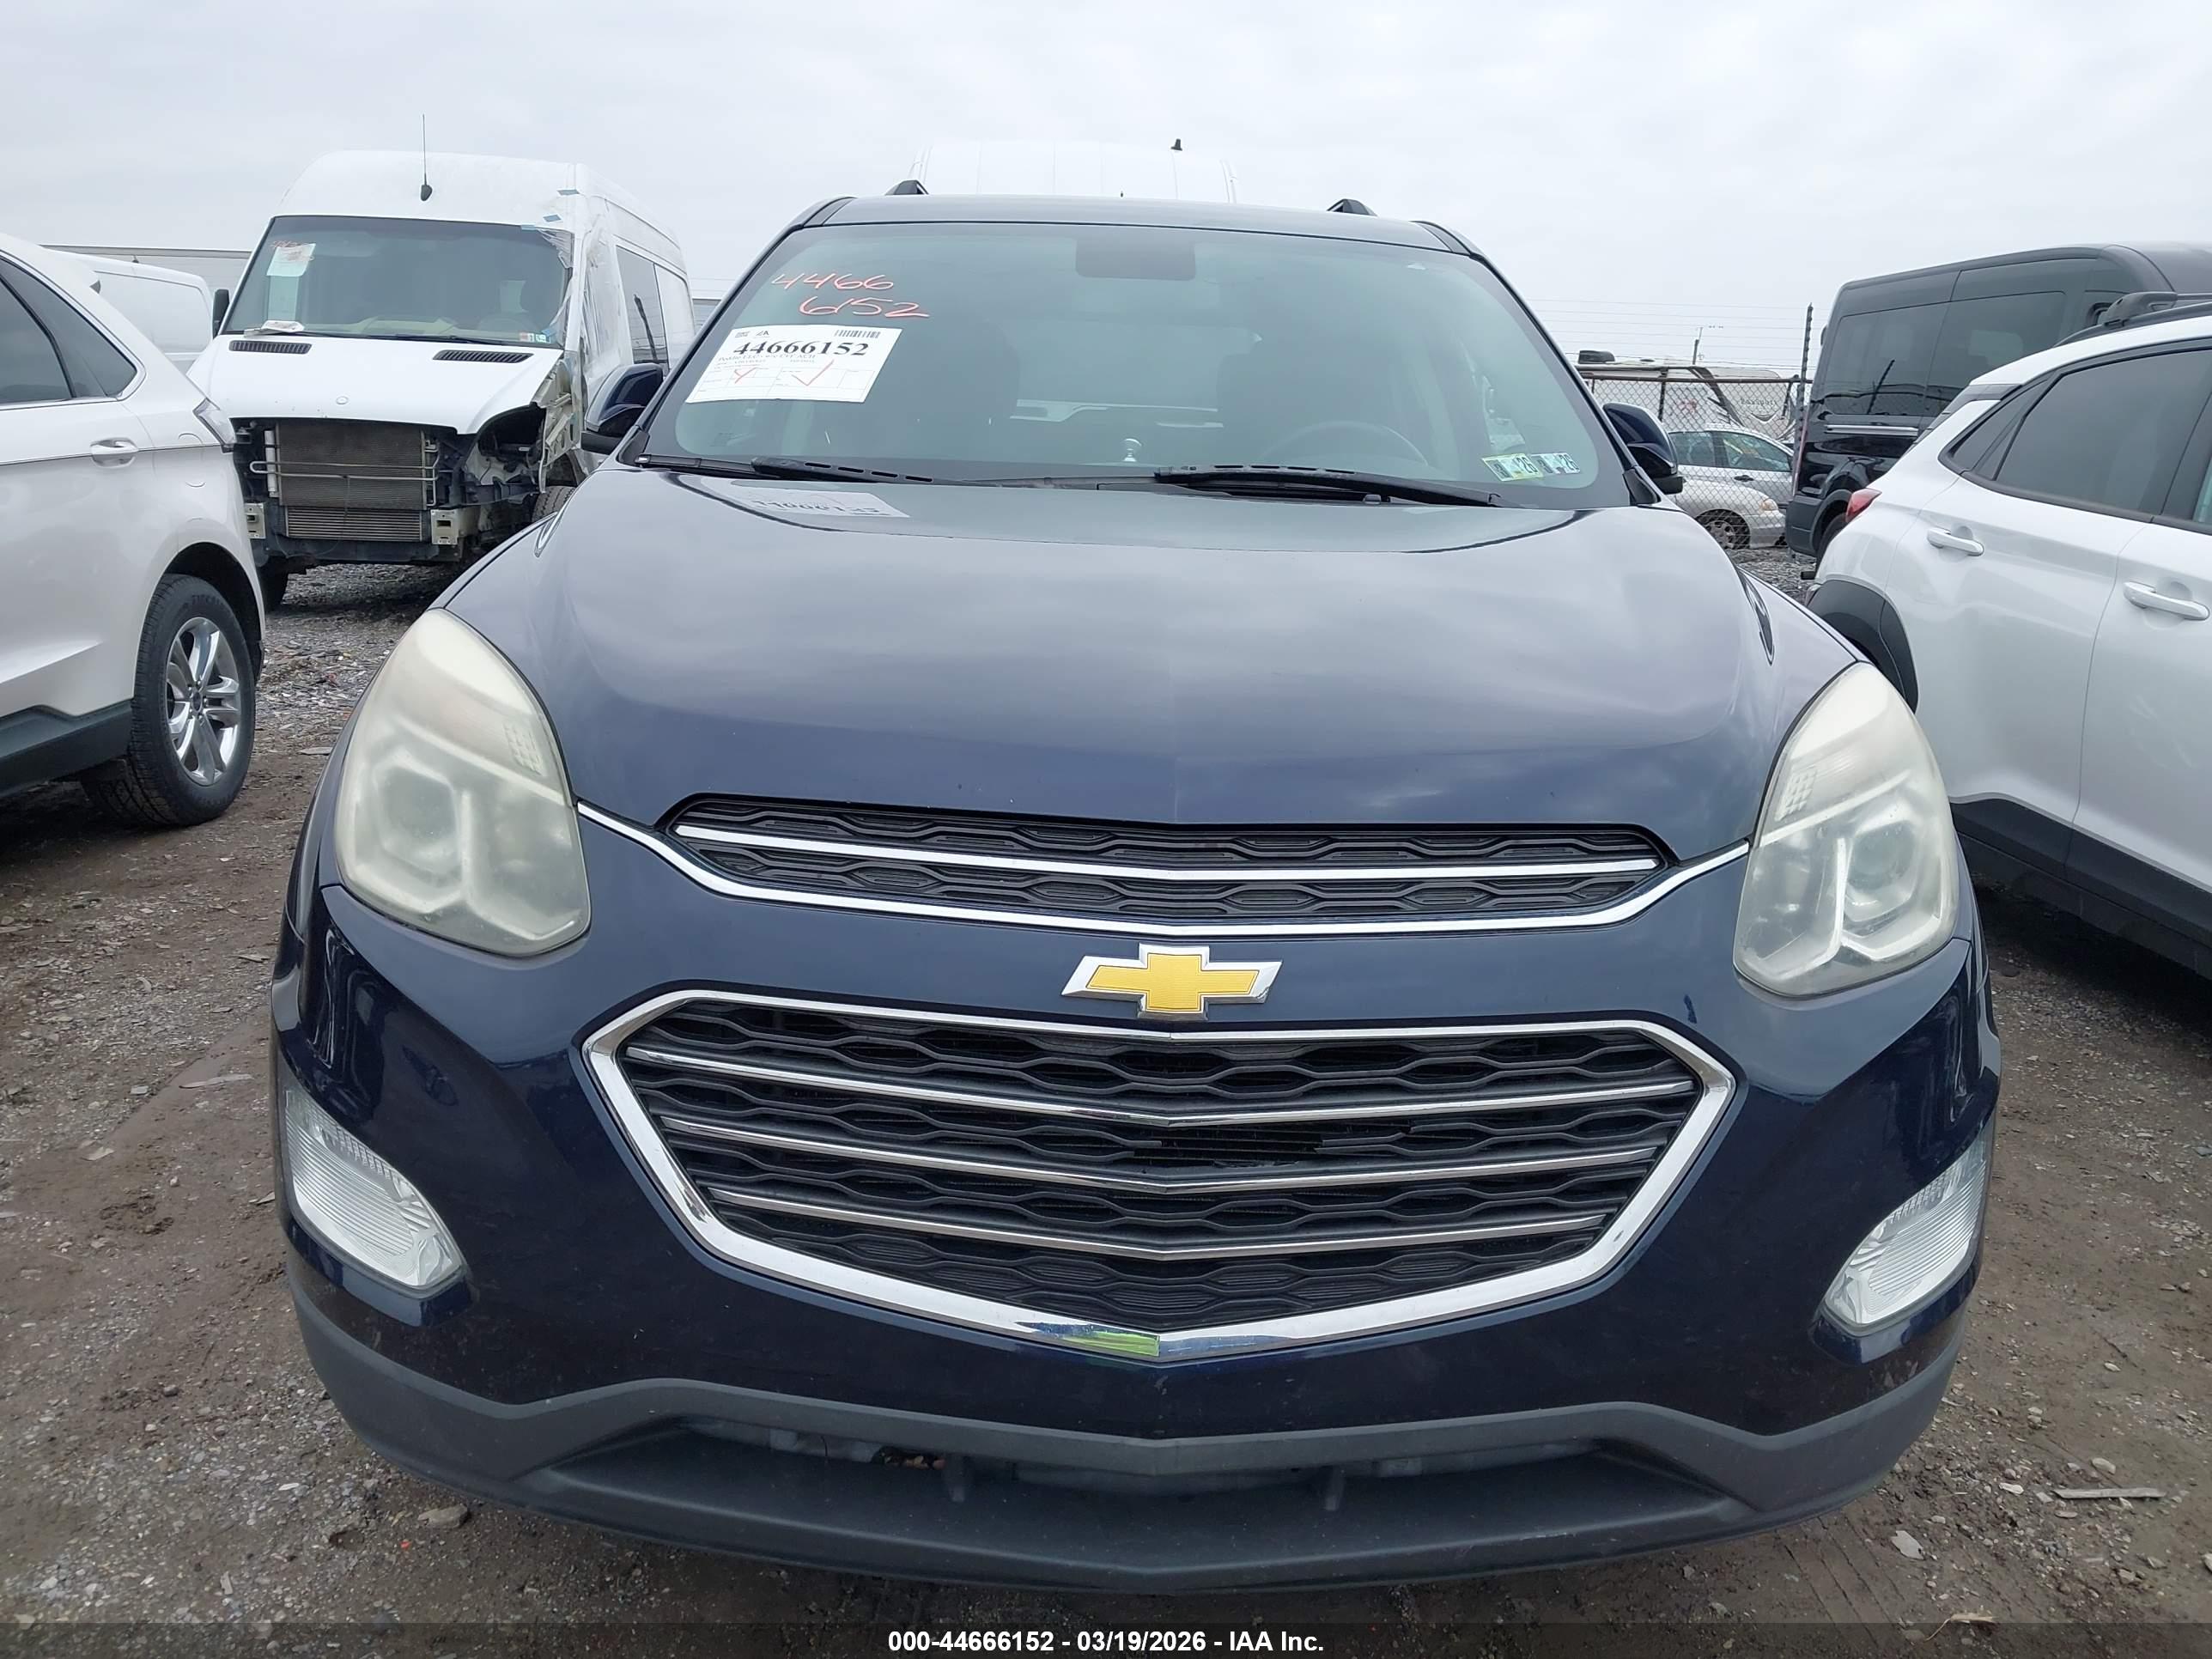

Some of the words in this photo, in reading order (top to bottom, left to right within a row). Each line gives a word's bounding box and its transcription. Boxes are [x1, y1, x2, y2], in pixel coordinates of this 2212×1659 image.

[771, 273, 894, 289] 4466
[799, 296, 929, 318] 6152
[733, 341, 870, 356] 44666152
[1558, 453, 1580, 471] 26
